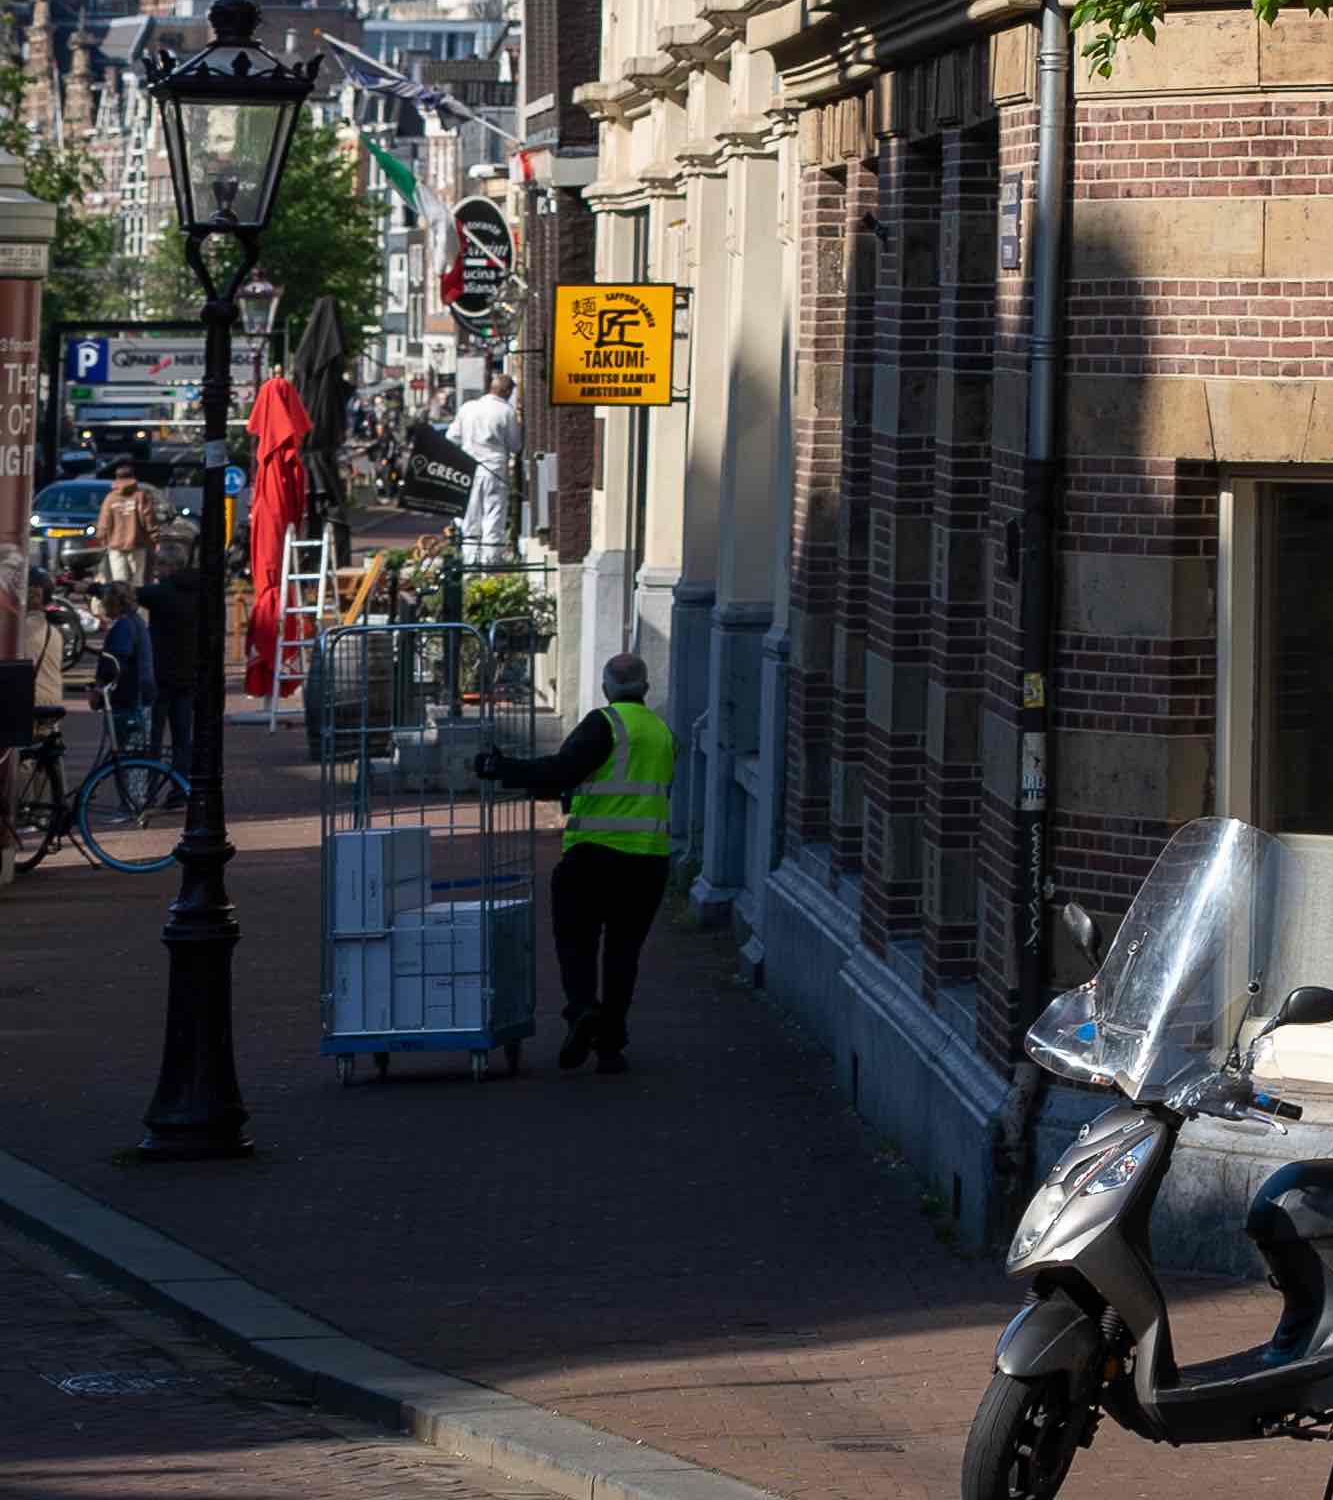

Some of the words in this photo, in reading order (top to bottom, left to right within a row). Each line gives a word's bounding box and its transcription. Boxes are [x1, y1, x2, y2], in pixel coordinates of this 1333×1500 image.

[464, 268, 496, 280] ucina
[464, 281, 498, 295] aliana
[594, 307, 644, 349] 匠
[77, 347, 99, 378] P
[580, 385, 642, 397] AMSTERDAM
[427, 461, 472, 488] GRECO
